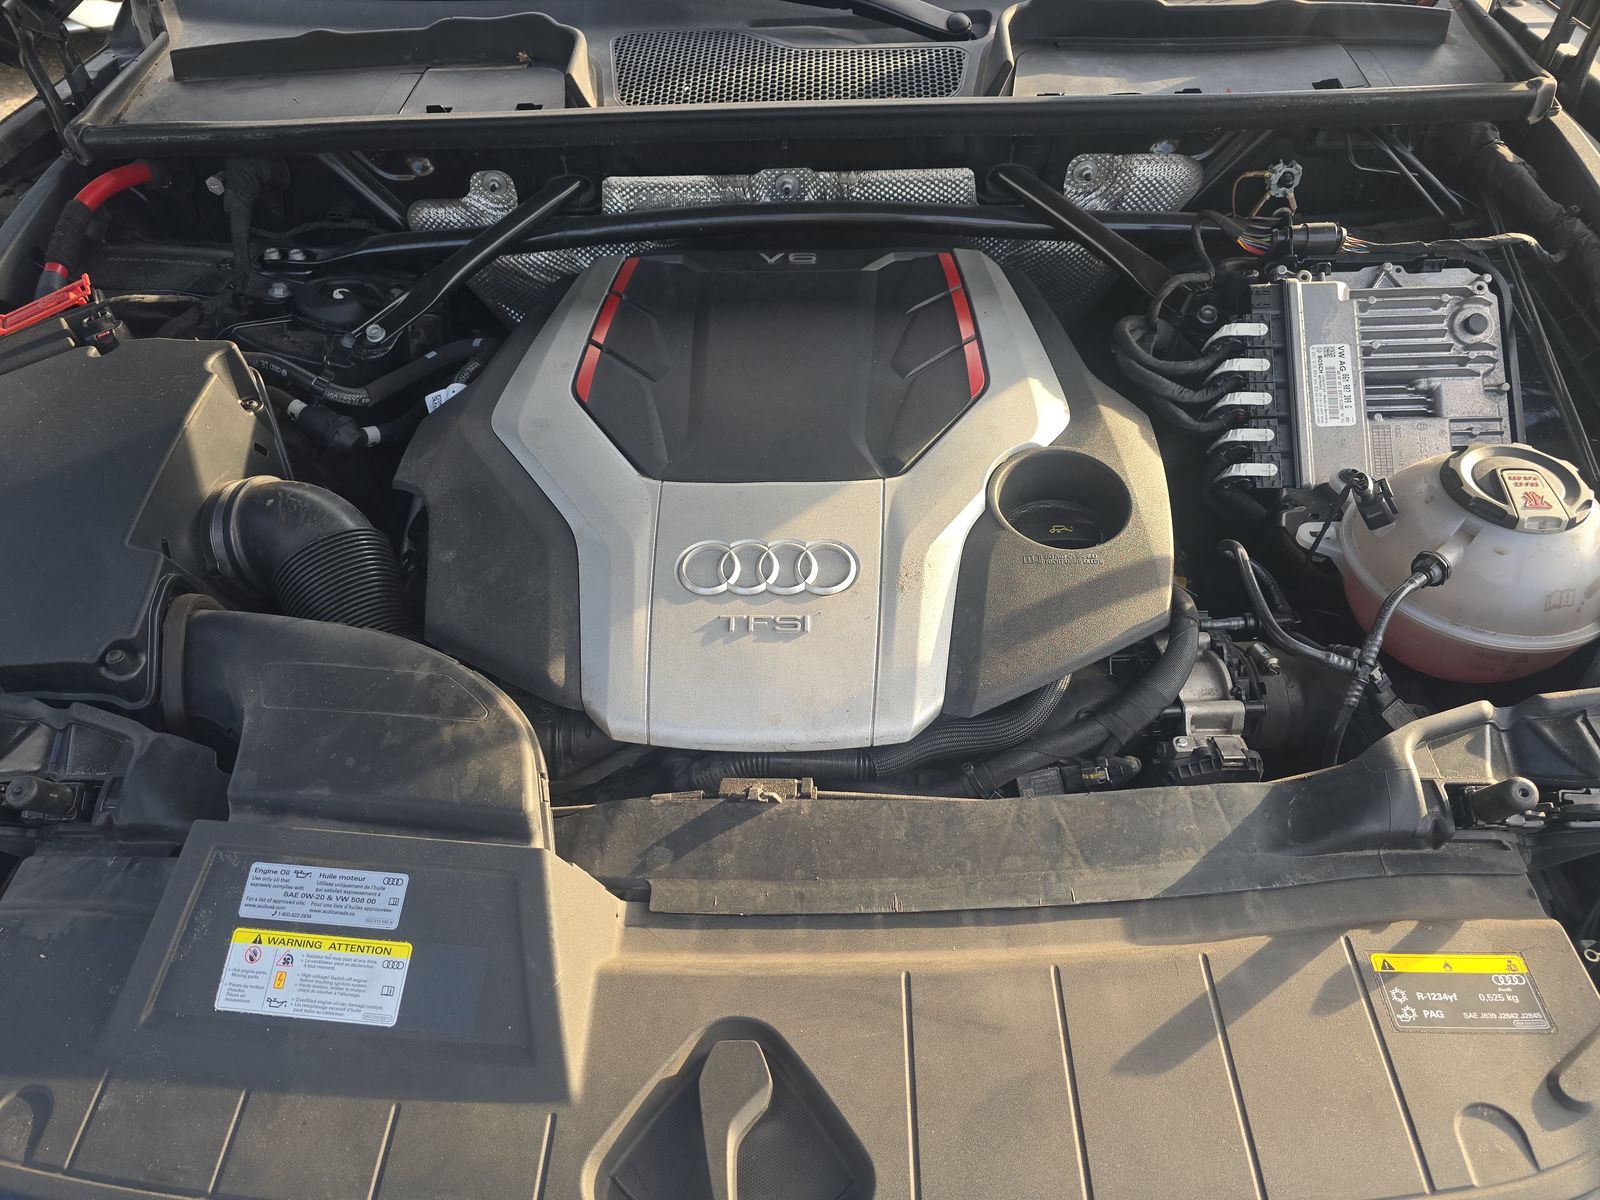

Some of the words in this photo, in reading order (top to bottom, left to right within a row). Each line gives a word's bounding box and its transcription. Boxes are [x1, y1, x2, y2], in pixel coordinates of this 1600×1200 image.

[759, 252, 817, 265] V6
[1337, 345, 1345, 359] VW
[1339, 360, 1347, 372] AG
[719, 615, 811, 633] TFSI
[254, 867, 278, 875] Engine
[319, 872, 337, 880] Huile
[335, 881, 363, 889] uniquement
[272, 898, 295, 906] approved
[283, 891, 299, 899] SAE
[300, 892, 325, 900] 0W-20
[335, 895, 349, 903] VW
[267, 936, 323, 949] WARNING
[328, 942, 393, 956] ATTENTION
[1416, 991, 1458, 1003] R-1234yf
[1478, 993, 1505, 1003] 0,525
[1506, 993, 1520, 1003] kg
[1422, 1009, 1445, 1019] PAG
